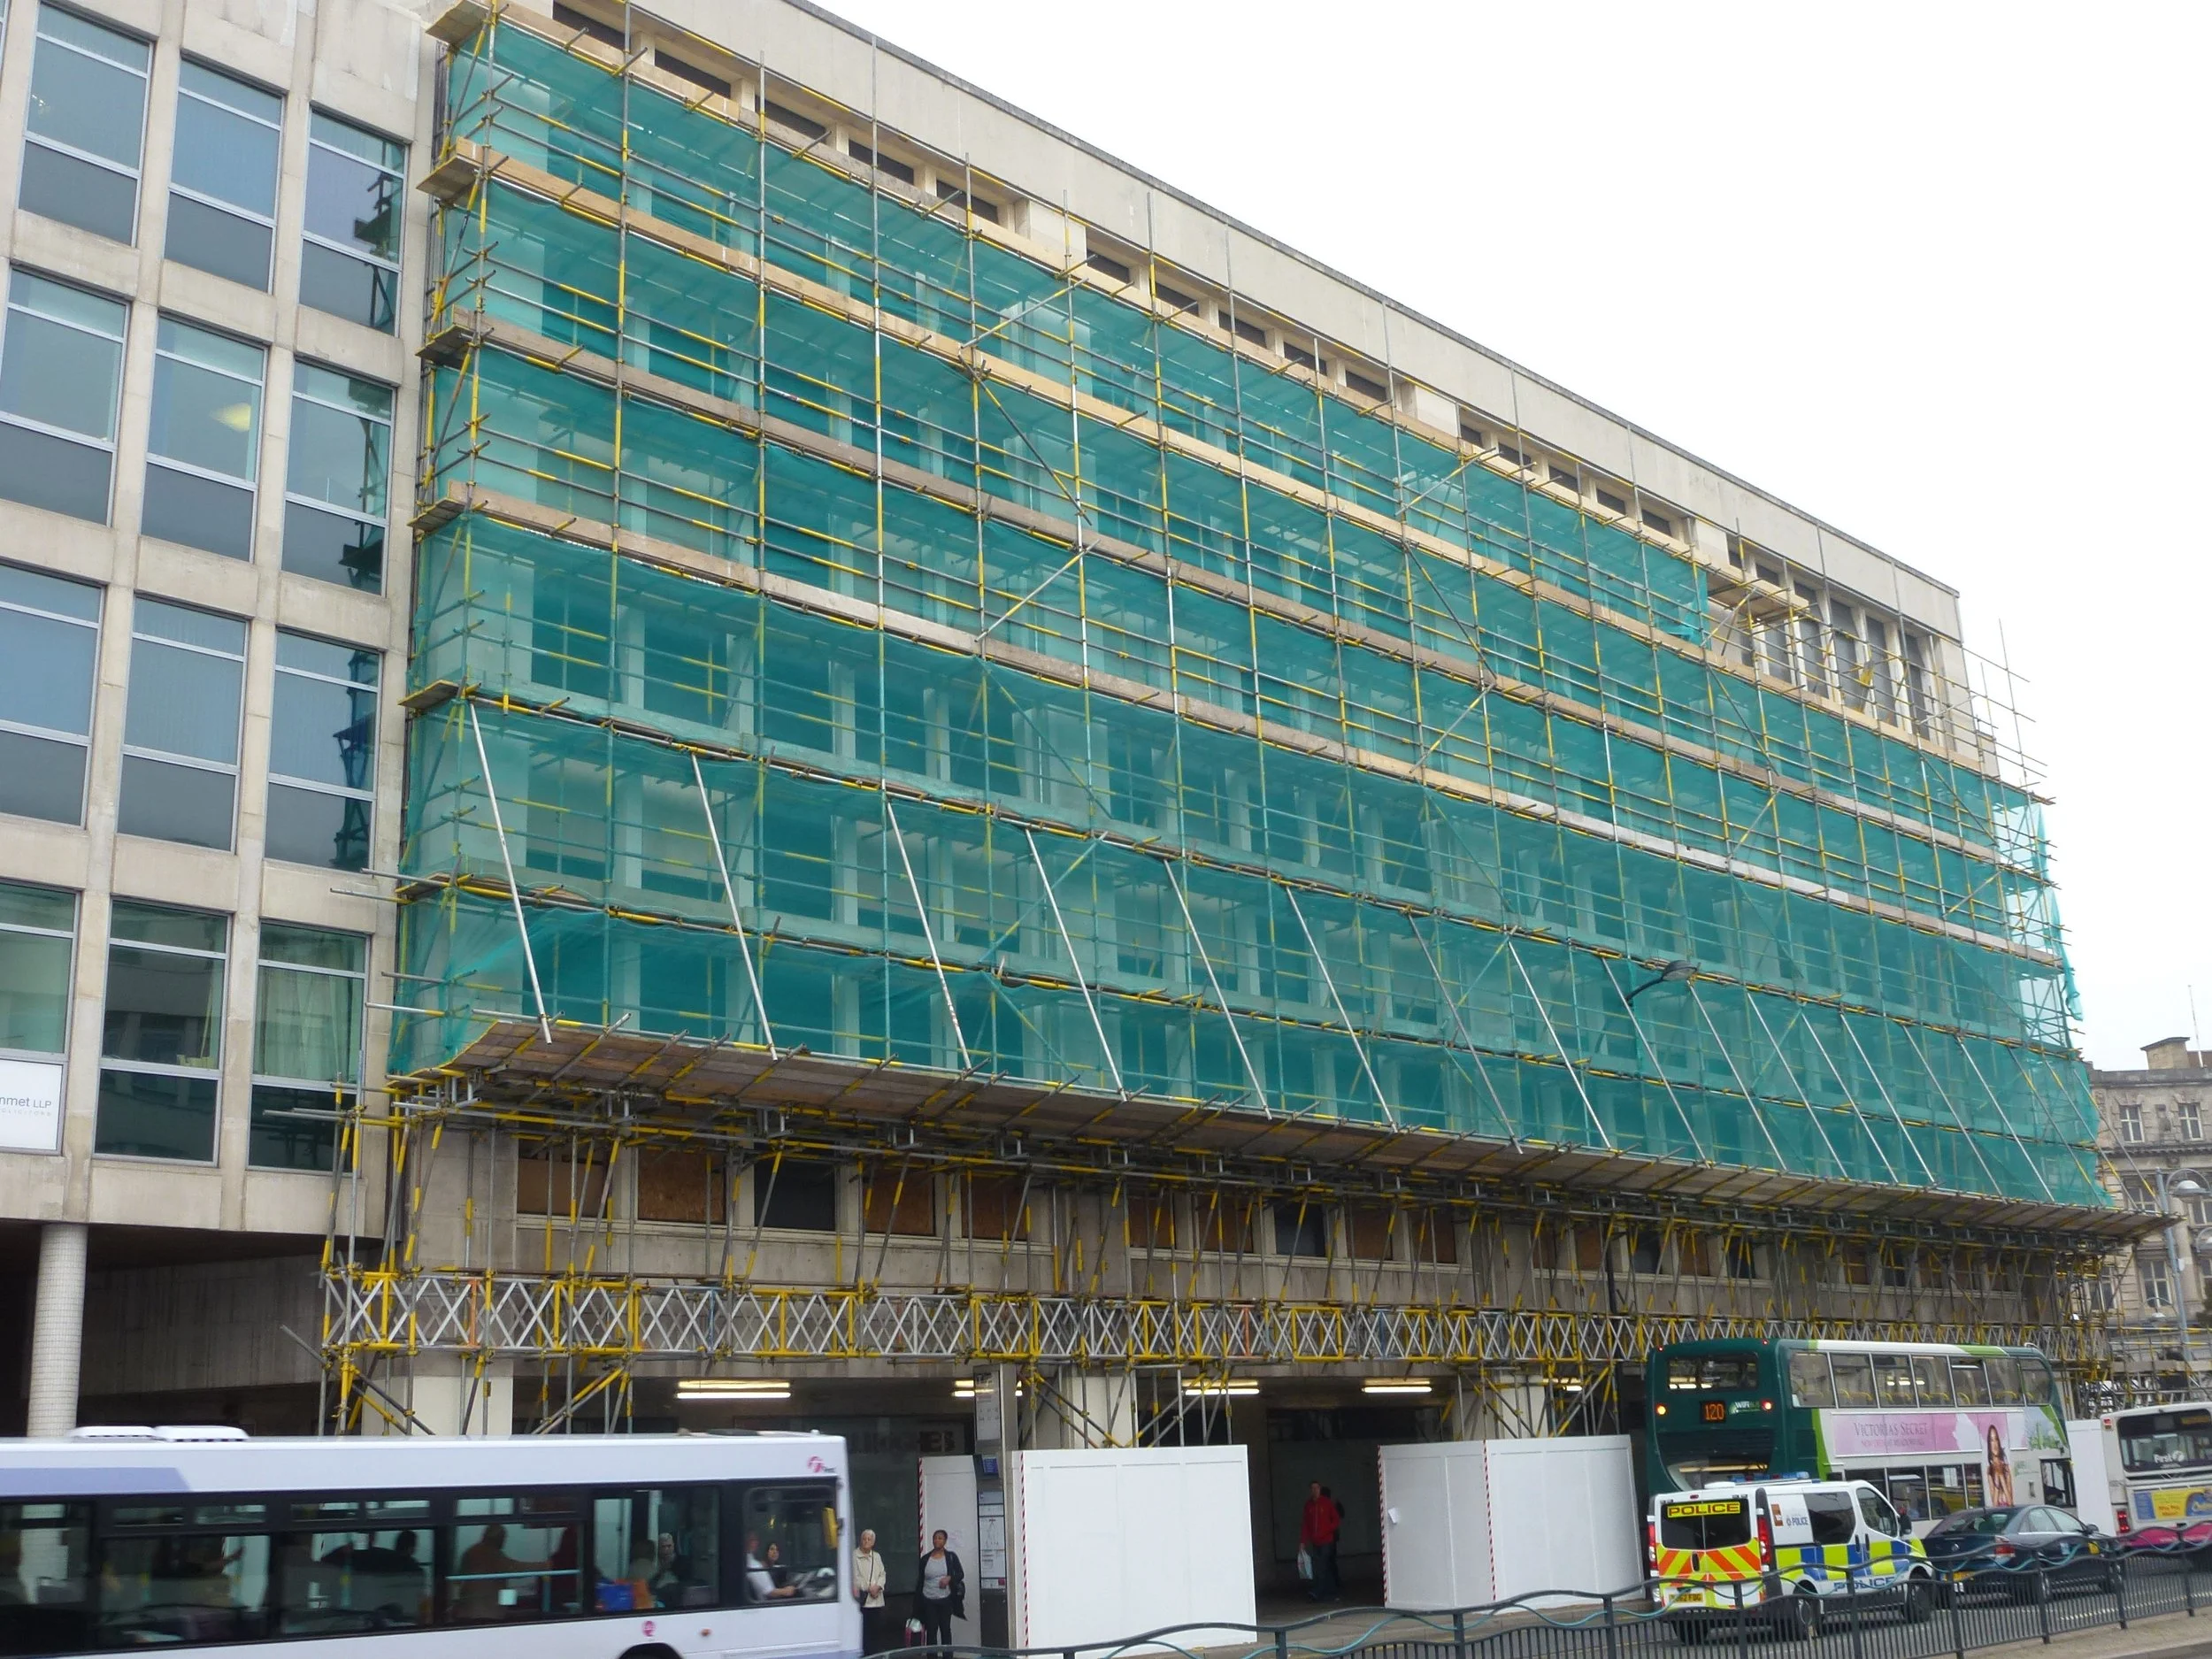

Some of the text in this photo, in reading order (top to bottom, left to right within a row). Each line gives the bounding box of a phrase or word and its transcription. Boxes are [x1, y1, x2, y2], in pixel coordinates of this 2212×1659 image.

[34, 1099, 52, 1108] LLP
[1704, 1403, 1724, 1420] 120
[1901, 1422, 1927, 1435] SECRET
[1669, 1502, 1740, 1516] POLICE
